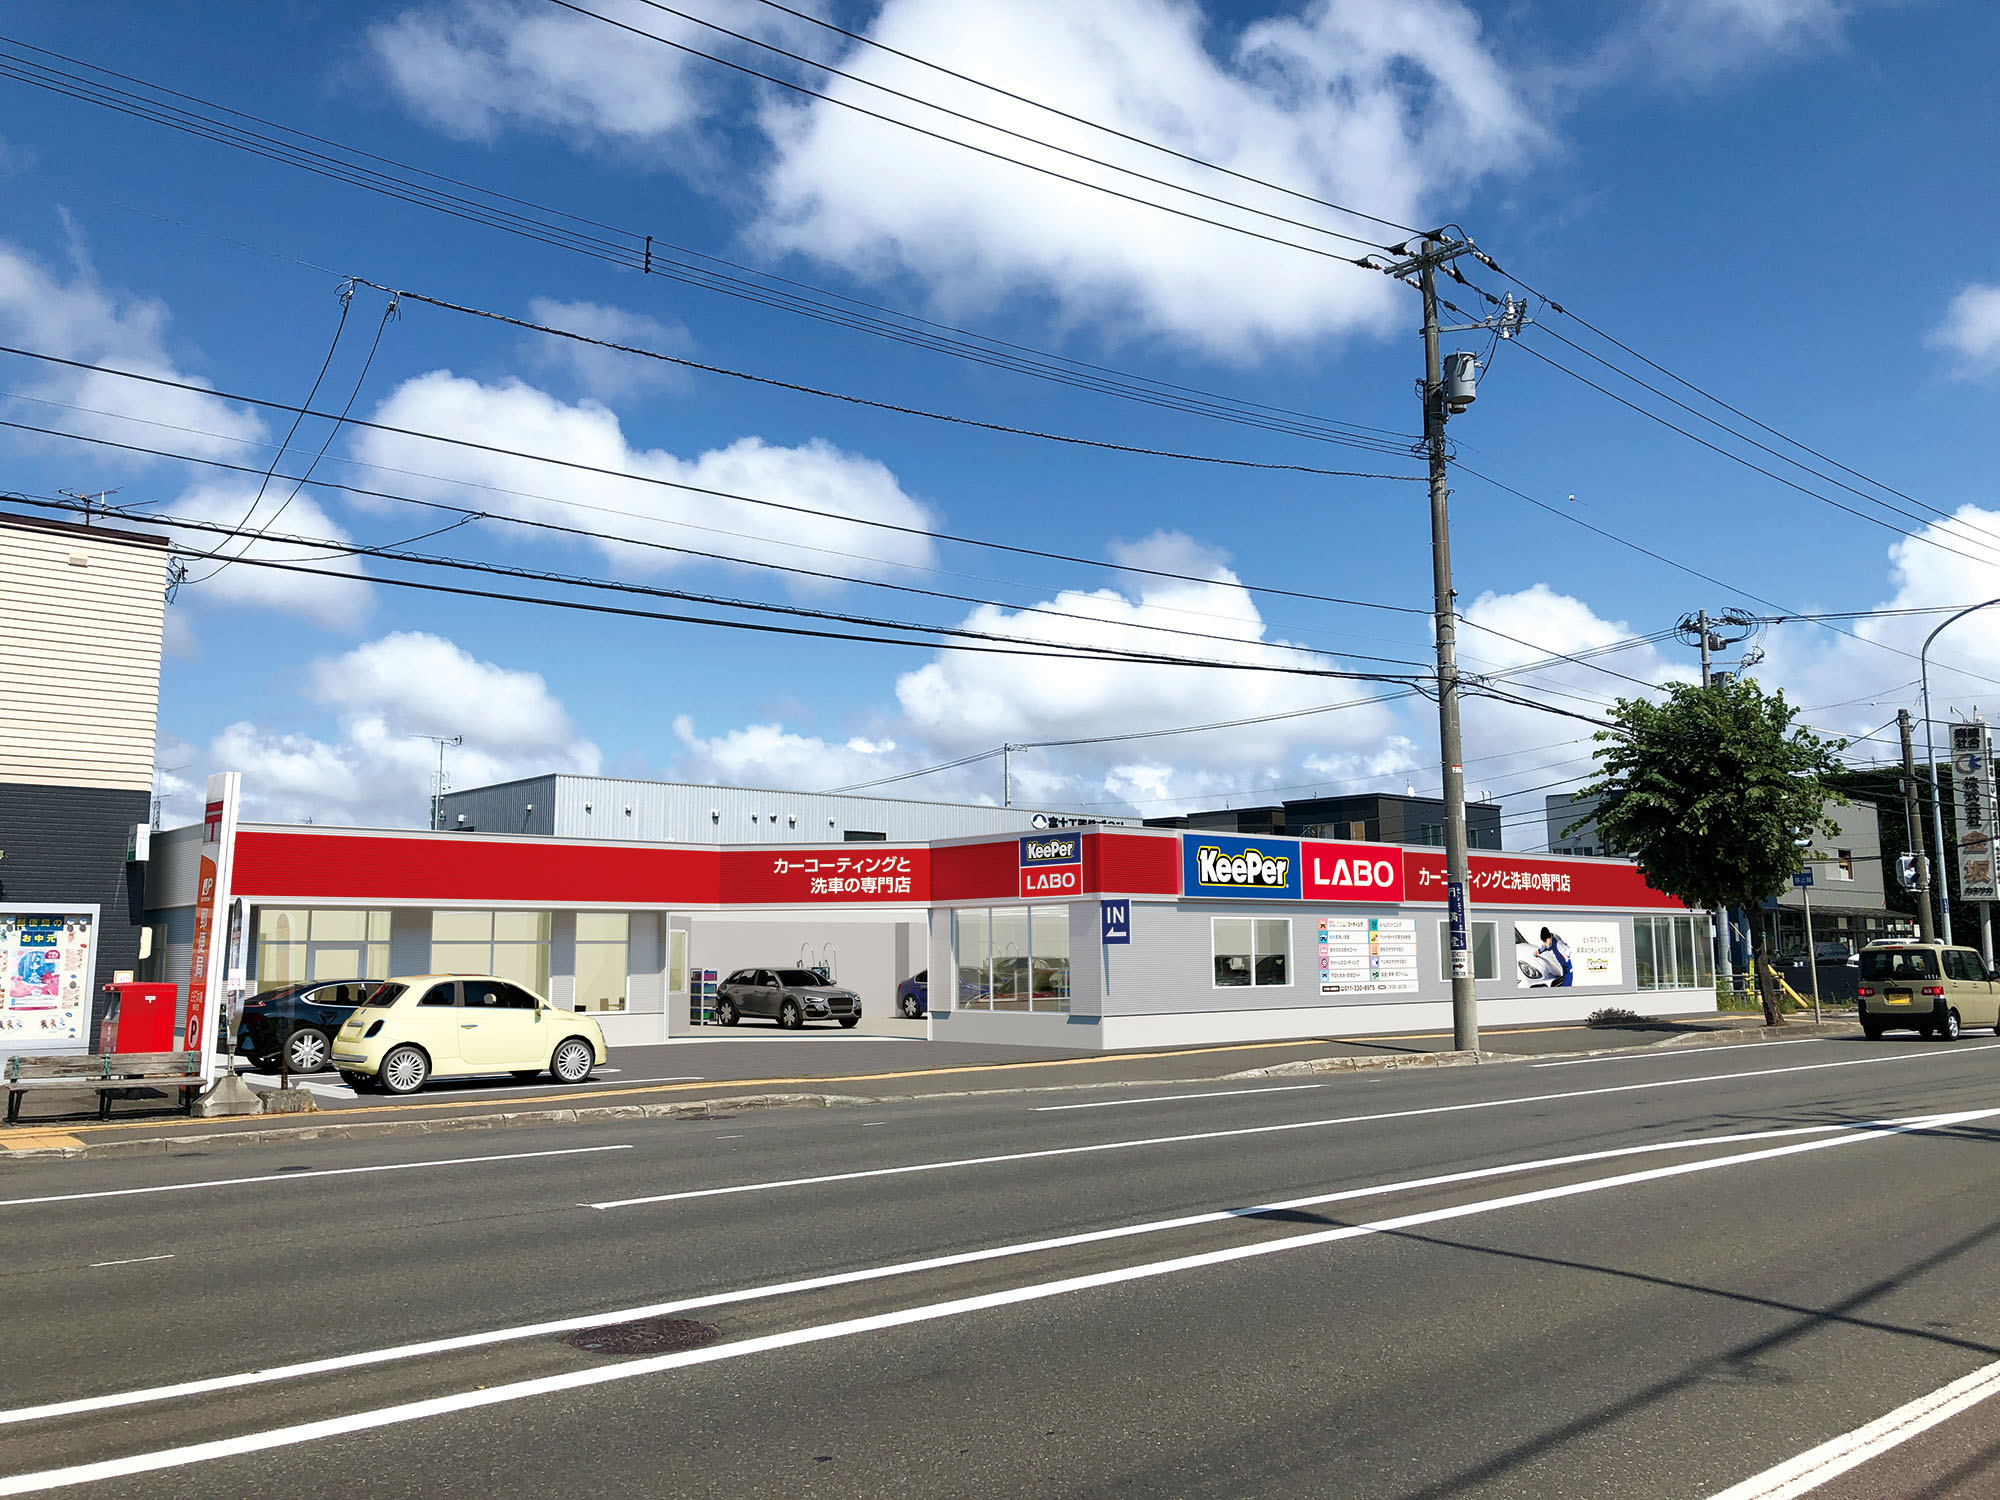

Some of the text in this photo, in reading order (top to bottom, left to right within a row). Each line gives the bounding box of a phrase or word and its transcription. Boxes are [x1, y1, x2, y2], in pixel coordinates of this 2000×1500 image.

[1963, 776, 1982, 829] 株式会社
[1027, 840, 1074, 861] KeePer
[1961, 830, 1992, 885] 金坂
[773, 857, 911, 875] カーコーティングと
[1197, 846, 1288, 887] KeePer
[1314, 858, 1395, 888] LABO
[810, 876, 911, 895] 洗車の専門店
[1026, 872, 1076, 890] LABO
[1419, 867, 1571, 892] カーコティングと洗車の専門店
[1107, 908, 1124, 925] IN
[22, 934, 56, 943] お中元
